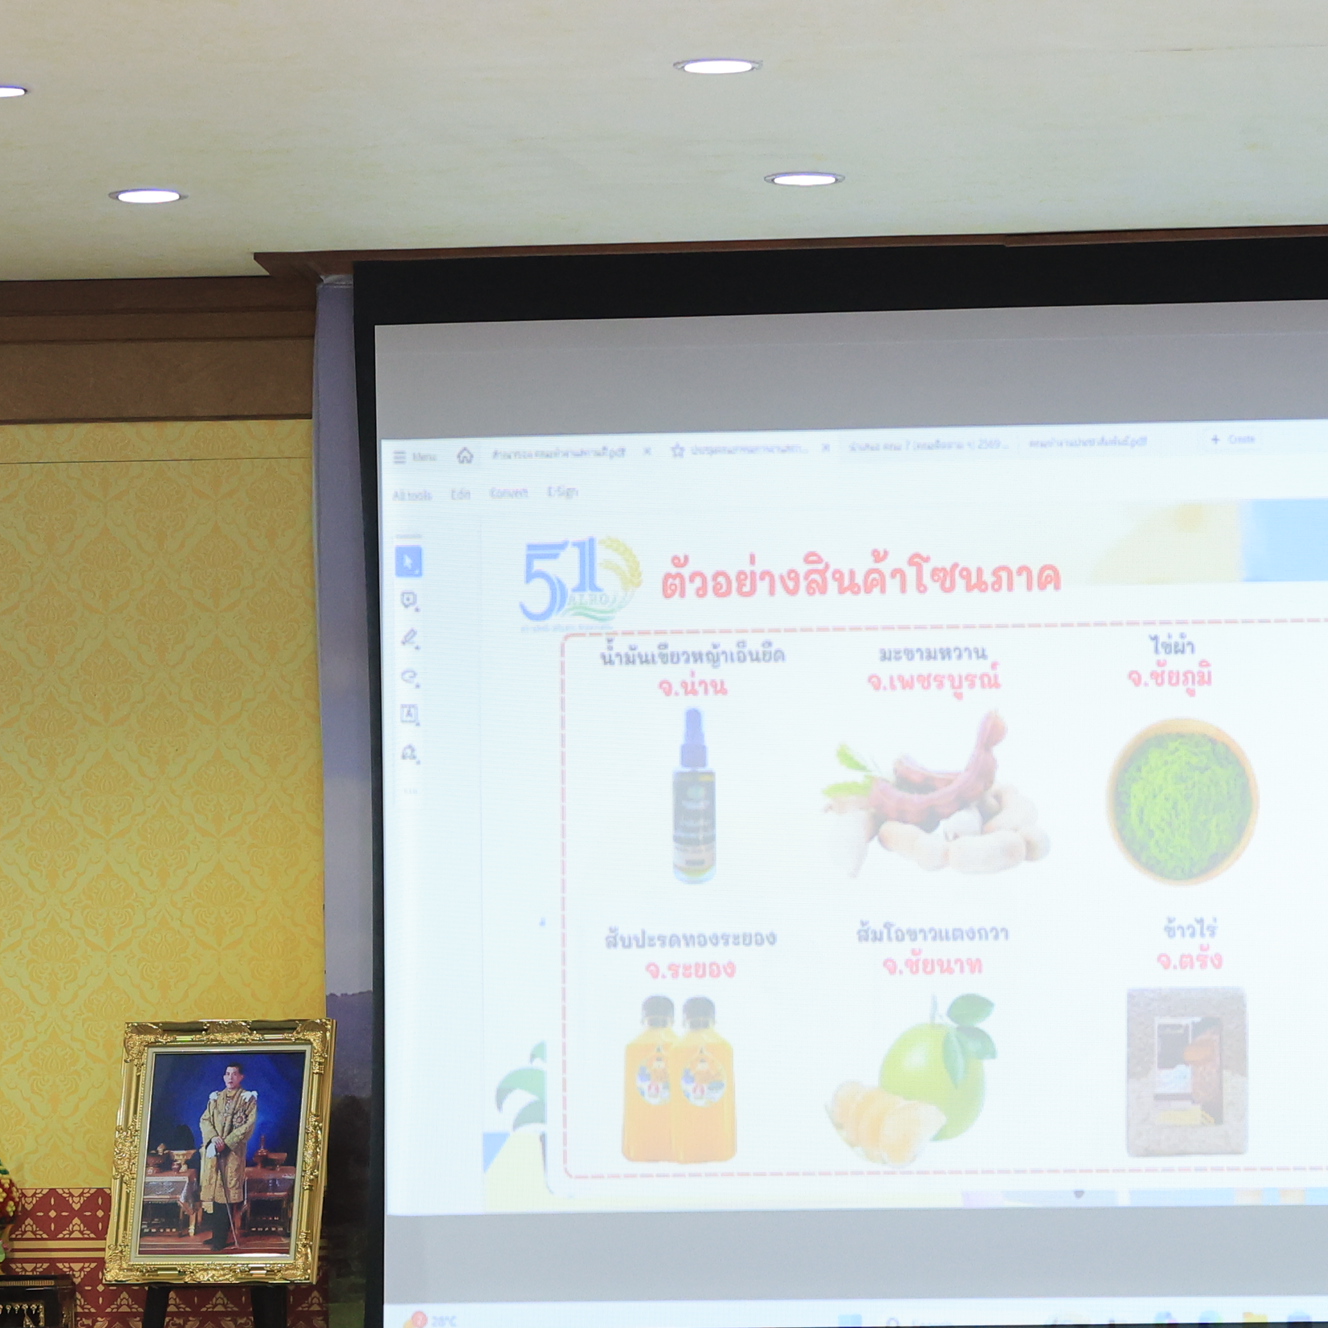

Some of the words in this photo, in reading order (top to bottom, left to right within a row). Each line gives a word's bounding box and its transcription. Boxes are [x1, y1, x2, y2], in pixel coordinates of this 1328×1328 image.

[450, 487, 471, 500] Edit
[489, 486, 529, 500] Convert
[661, 548, 1062, 600] ตัวอย่างสินค้าโซนภาค
[879, 645, 988, 664] มะขามหวาน
[658, 670, 728, 697] จ.น่าน
[867, 661, 1002, 700] จ.เพชรบูรณ์
[1127, 659, 1213, 698] จ.ชัยภูมิ
[604, 926, 778, 950] สับปะรดทองระยอง
[855, 919, 1010, 944] ส้มโอขาวแตงกวา
[1163, 916, 1218, 940] ข้าวไร่
[882, 947, 983, 976] จ.ชัยนาท
[1156, 943, 1224, 971] จ.ตรัง
[644, 960, 737, 980] จ.ระยอง
